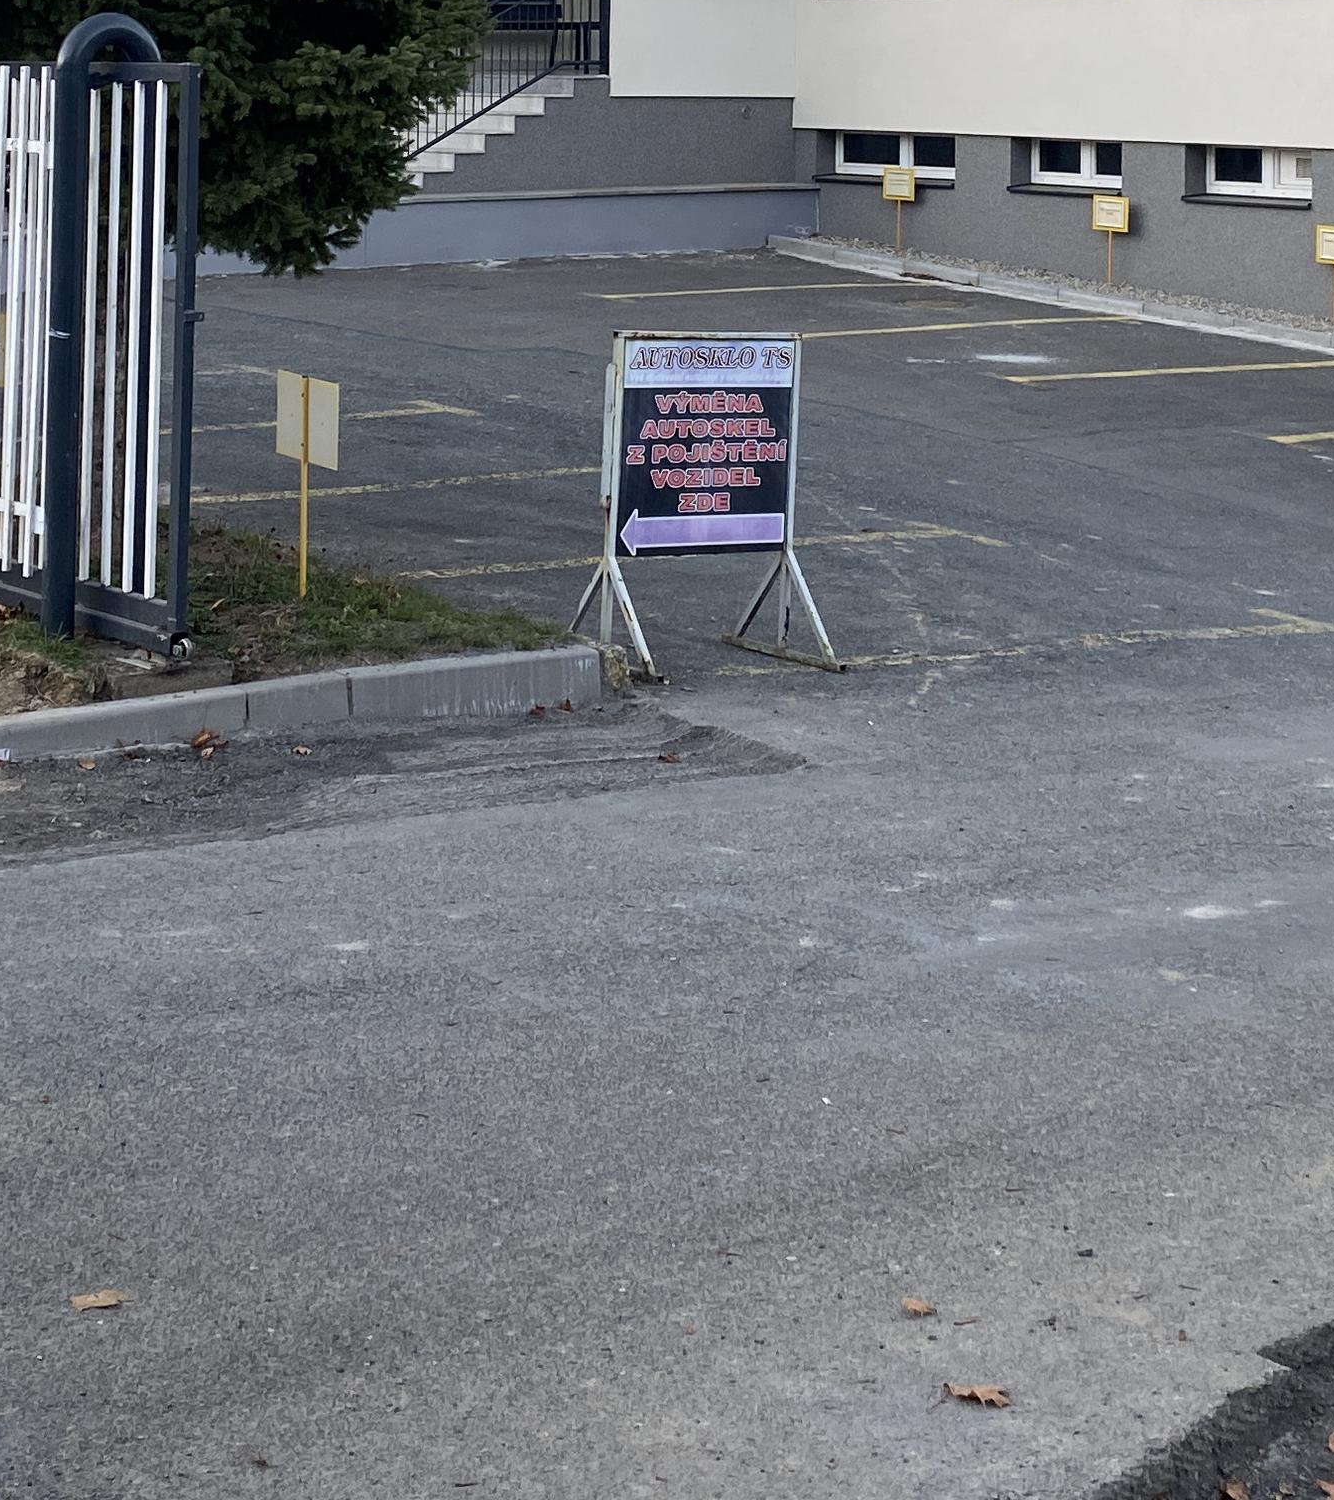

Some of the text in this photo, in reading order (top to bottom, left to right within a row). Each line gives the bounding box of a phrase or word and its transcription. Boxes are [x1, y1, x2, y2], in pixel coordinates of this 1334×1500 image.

[630, 346, 793, 369] AUTOSKLO TS
[655, 391, 764, 414] VÝMĚNA
[640, 418, 776, 439] AUTOSKEL
[626, 439, 788, 465] Z POJIŠTĚNÍ
[650, 467, 761, 488] VOZIDEL
[678, 492, 730, 512] ZDE
